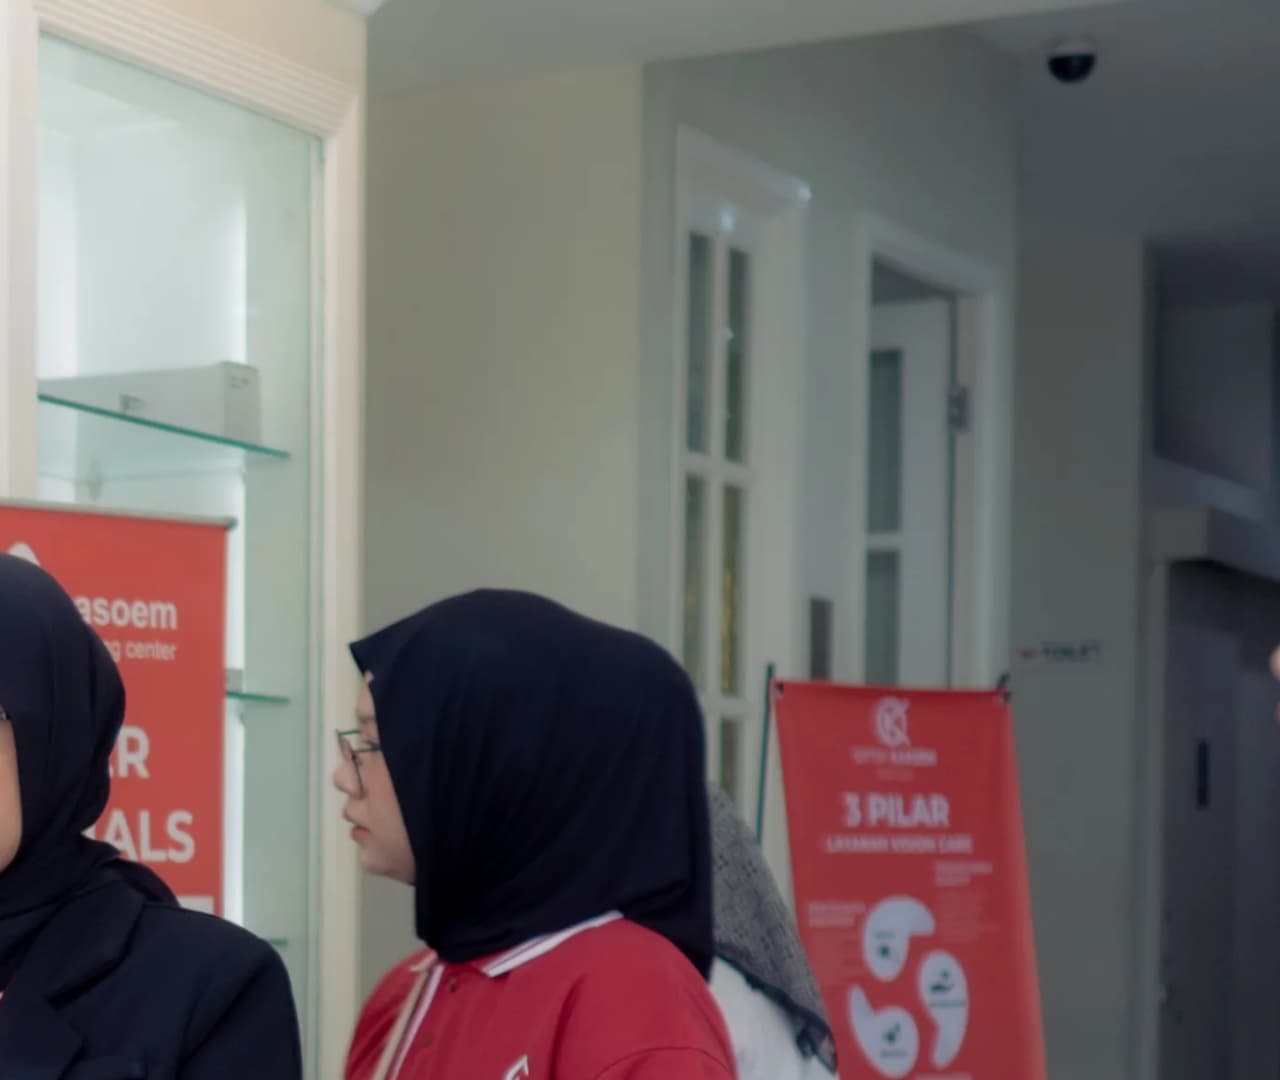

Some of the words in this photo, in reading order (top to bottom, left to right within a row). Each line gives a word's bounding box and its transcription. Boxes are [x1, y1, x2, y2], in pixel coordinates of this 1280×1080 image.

[72, 596, 177, 630] asoem
[843, 792, 861, 828] 3
[868, 792, 950, 828] PILAR
